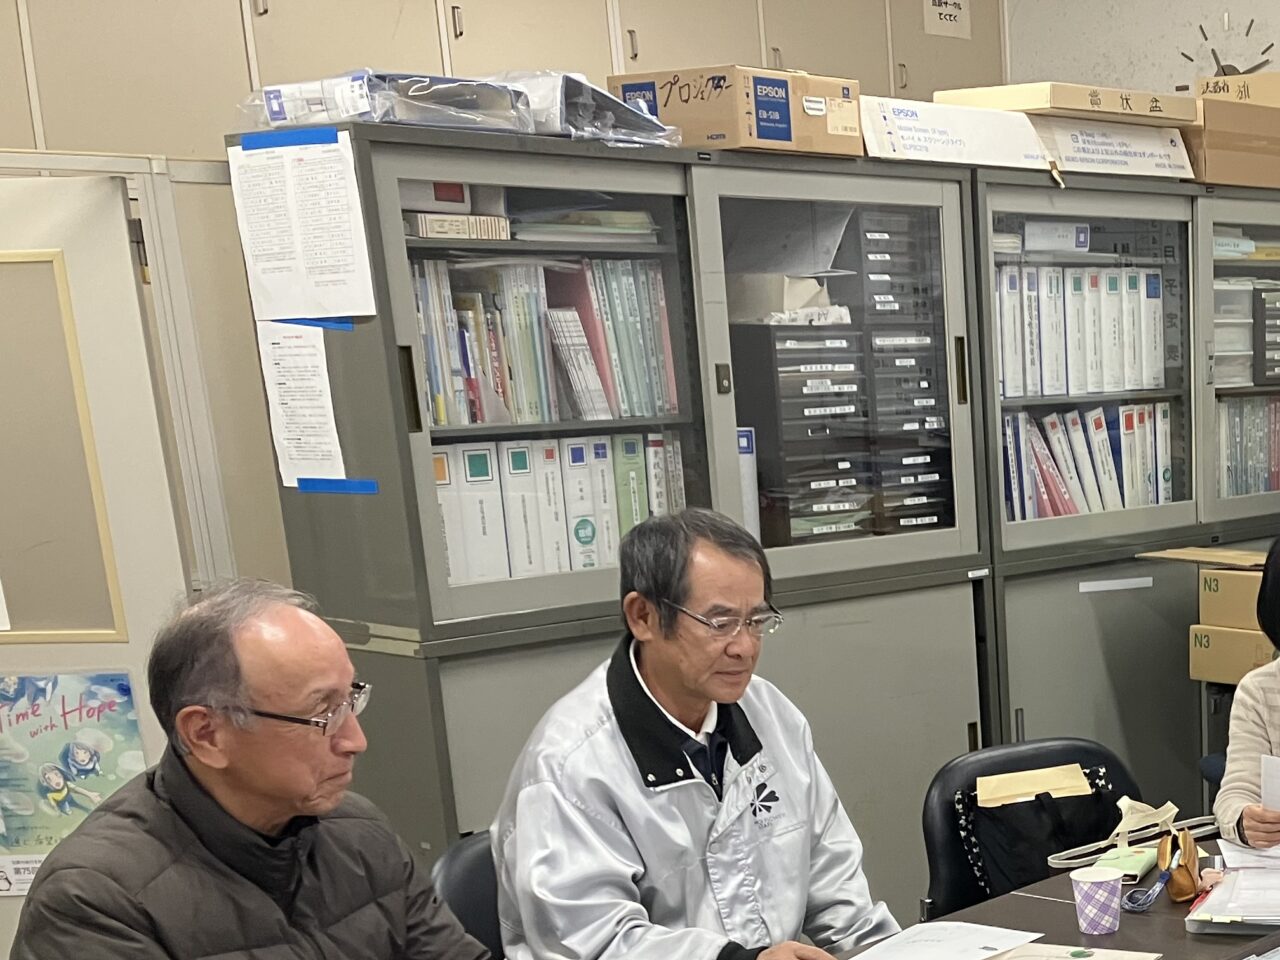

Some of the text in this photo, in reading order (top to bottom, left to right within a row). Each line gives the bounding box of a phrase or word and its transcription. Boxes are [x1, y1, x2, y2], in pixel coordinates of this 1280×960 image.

[938, 13, 958, 23] てくてく
[757, 85, 785, 99] EPSON
[892, 108, 918, 118] EPSON
[1204, 577, 1219, 593] N3
[1194, 633, 1210, 649] N3
[60, 693, 118, 730] Hope
[30, 716, 58, 738] with
